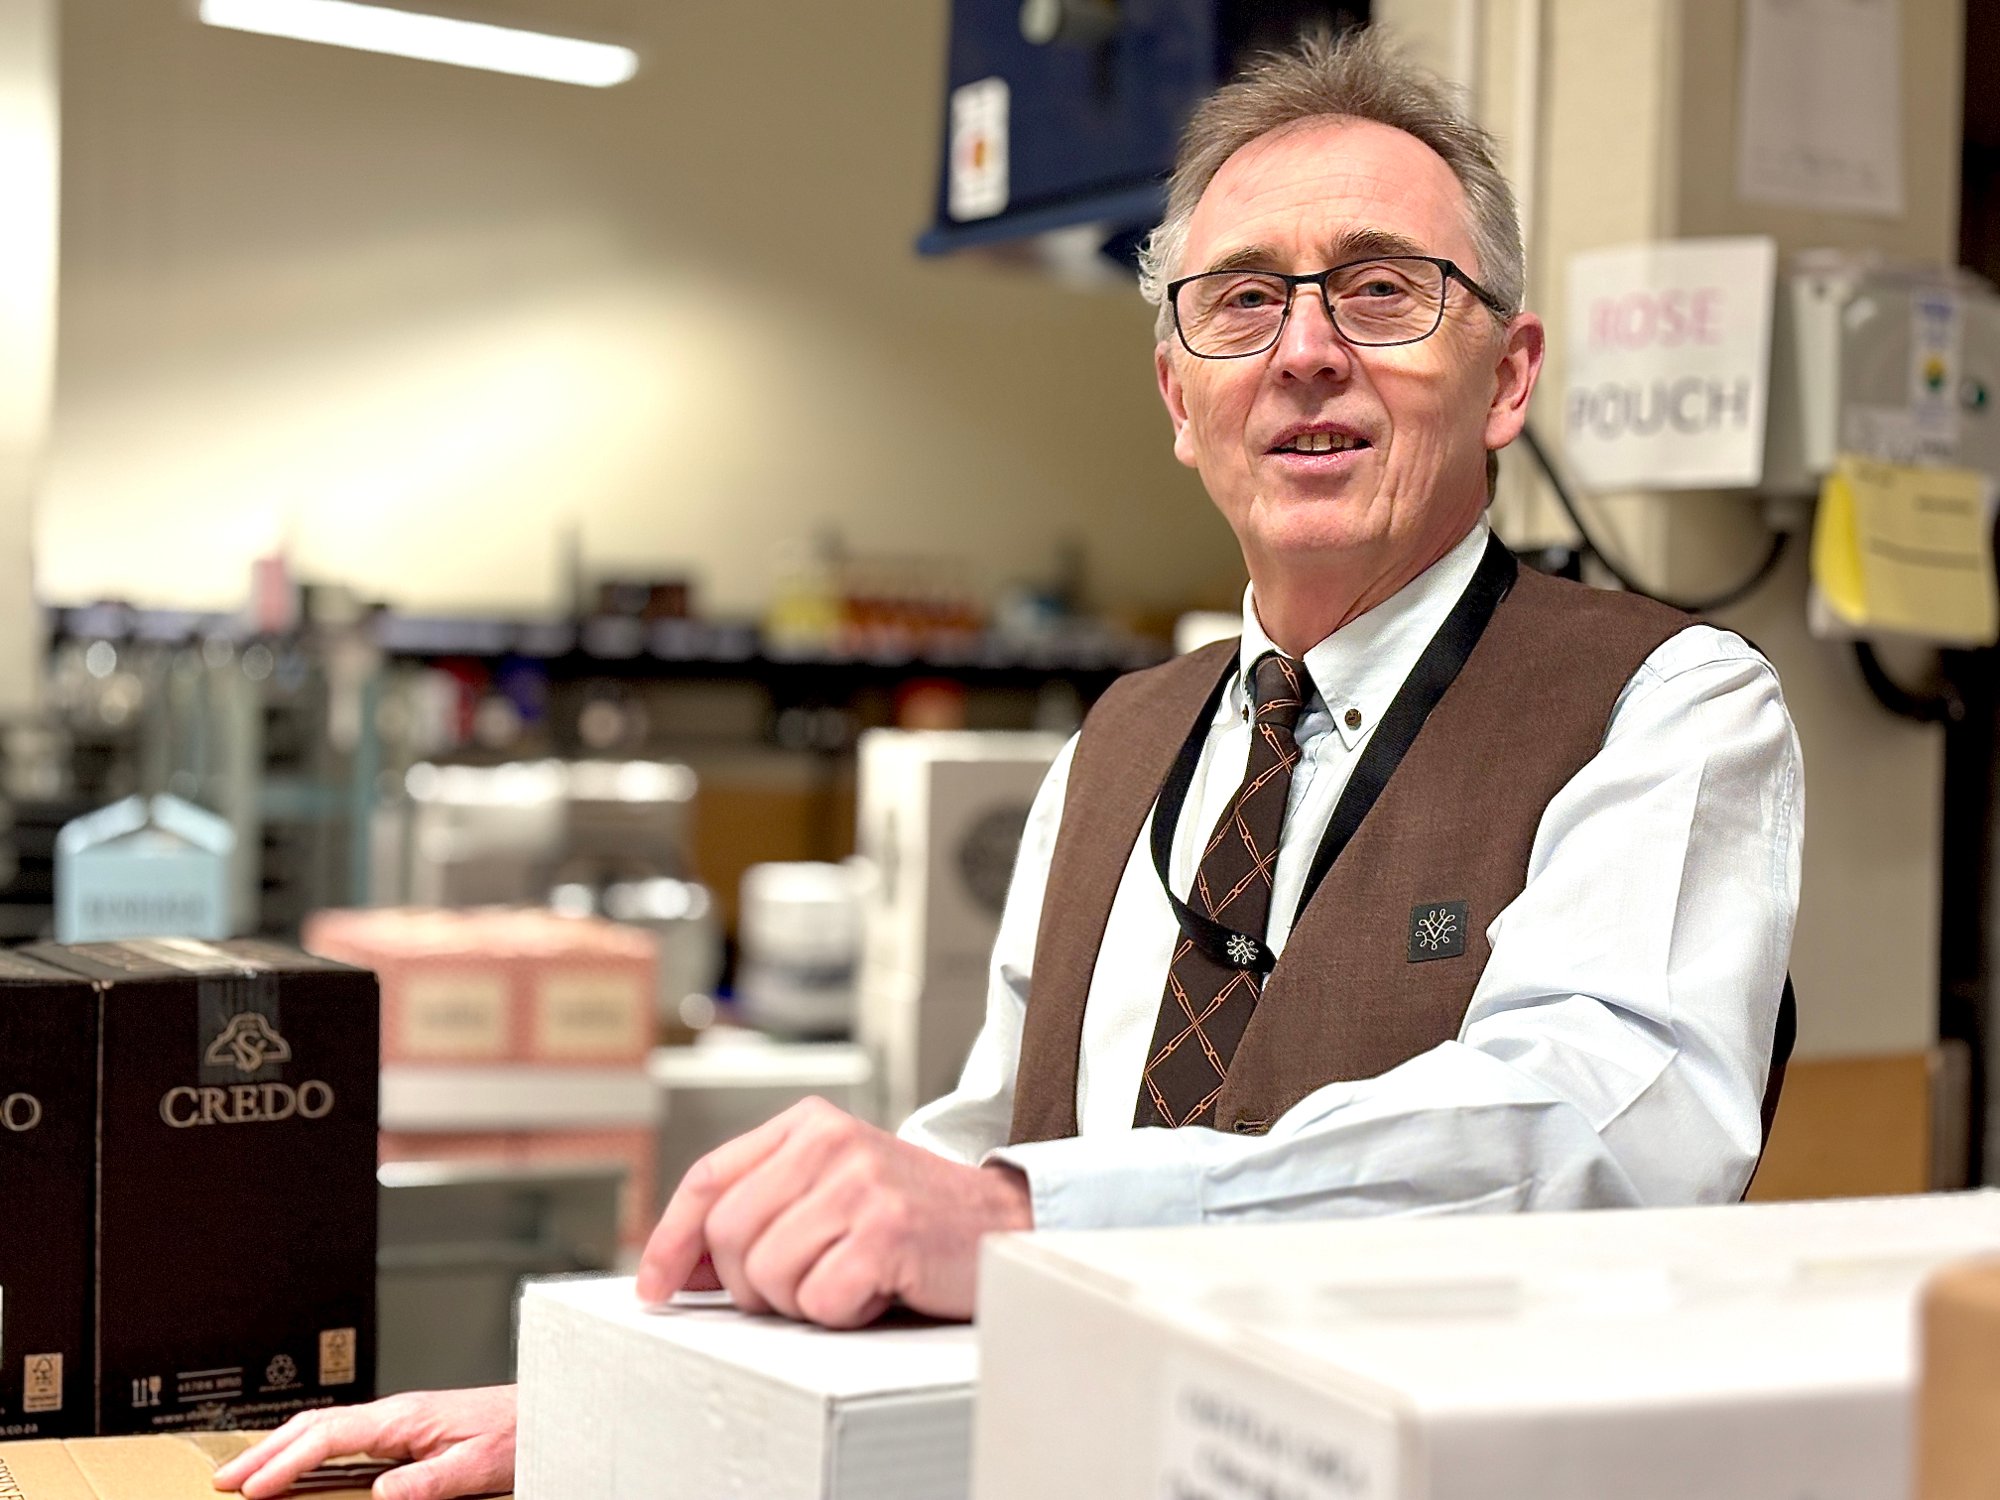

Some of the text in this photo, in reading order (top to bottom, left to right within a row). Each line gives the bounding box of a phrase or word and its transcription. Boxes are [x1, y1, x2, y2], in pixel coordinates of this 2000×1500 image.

[1588, 287, 1725, 349] ROSE
[1568, 377, 1750, 441] POUCH
[160, 1080, 335, 1128] CREDO
